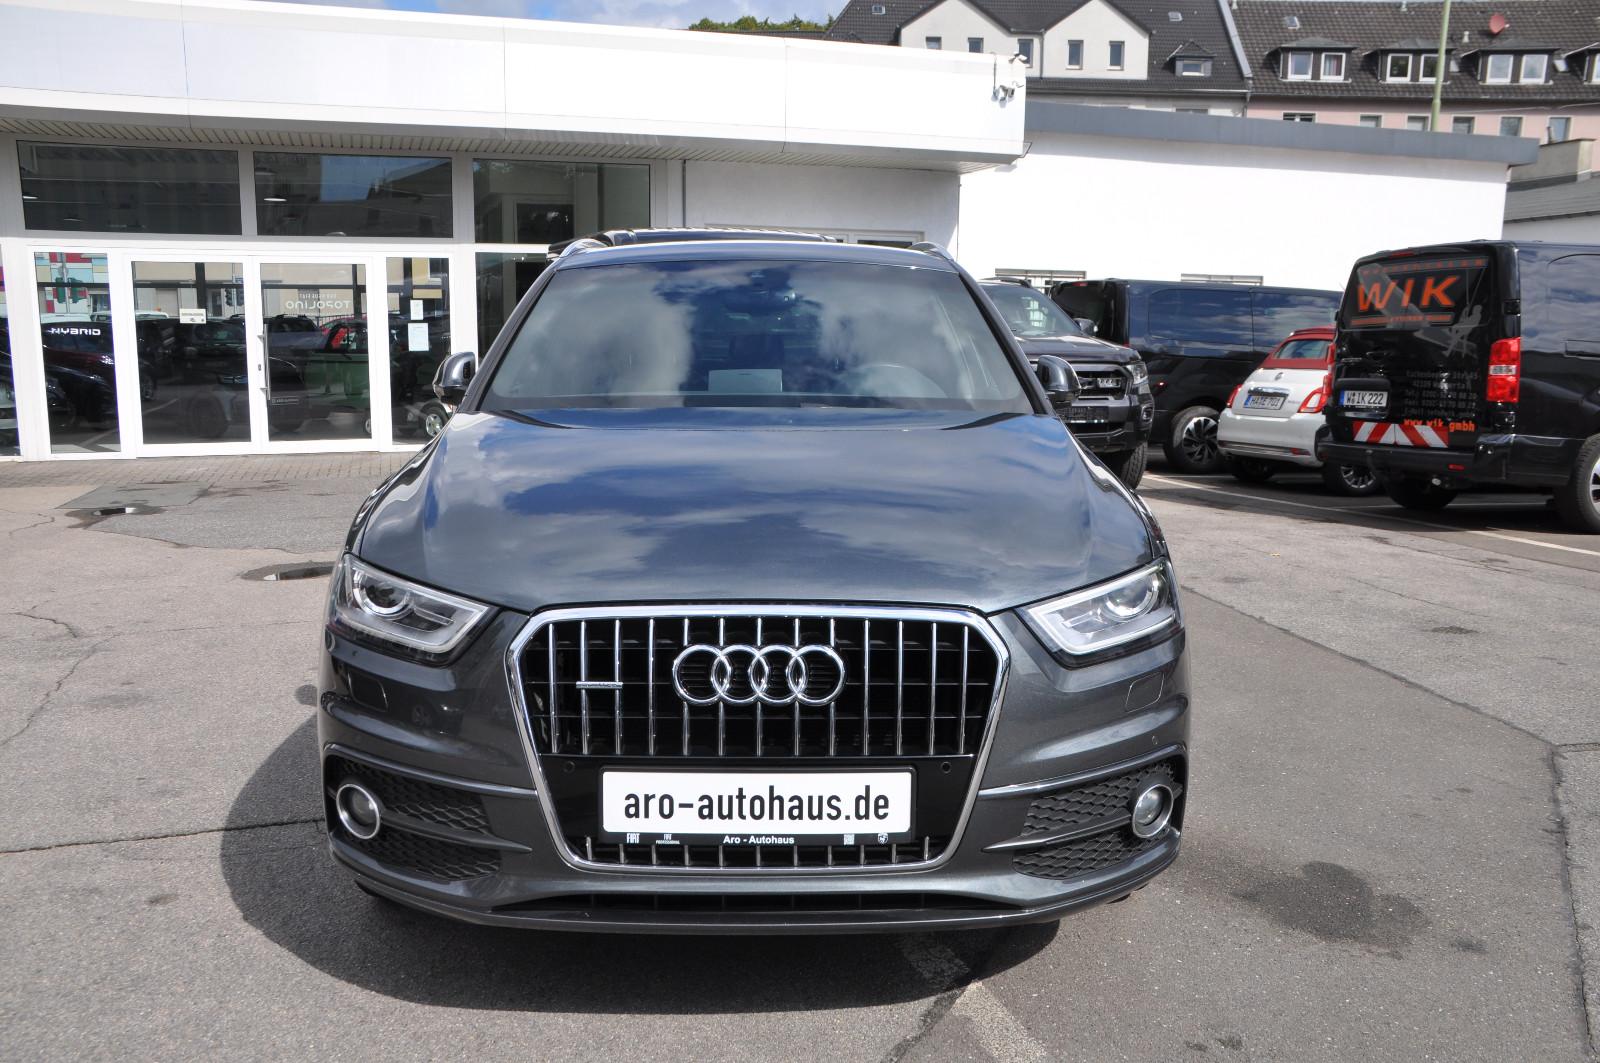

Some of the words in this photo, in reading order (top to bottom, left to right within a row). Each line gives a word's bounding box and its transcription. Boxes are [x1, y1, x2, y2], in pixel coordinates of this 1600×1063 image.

[1357, 275, 1460, 313] WIK
[47, 327, 101, 335] HYBRID
[625, 785, 889, 821] aro-autohaus.de
[626, 833, 640, 844] FIAT
[723, 835, 742, 844] Aro
[748, 835, 795, 844] Autohaus
